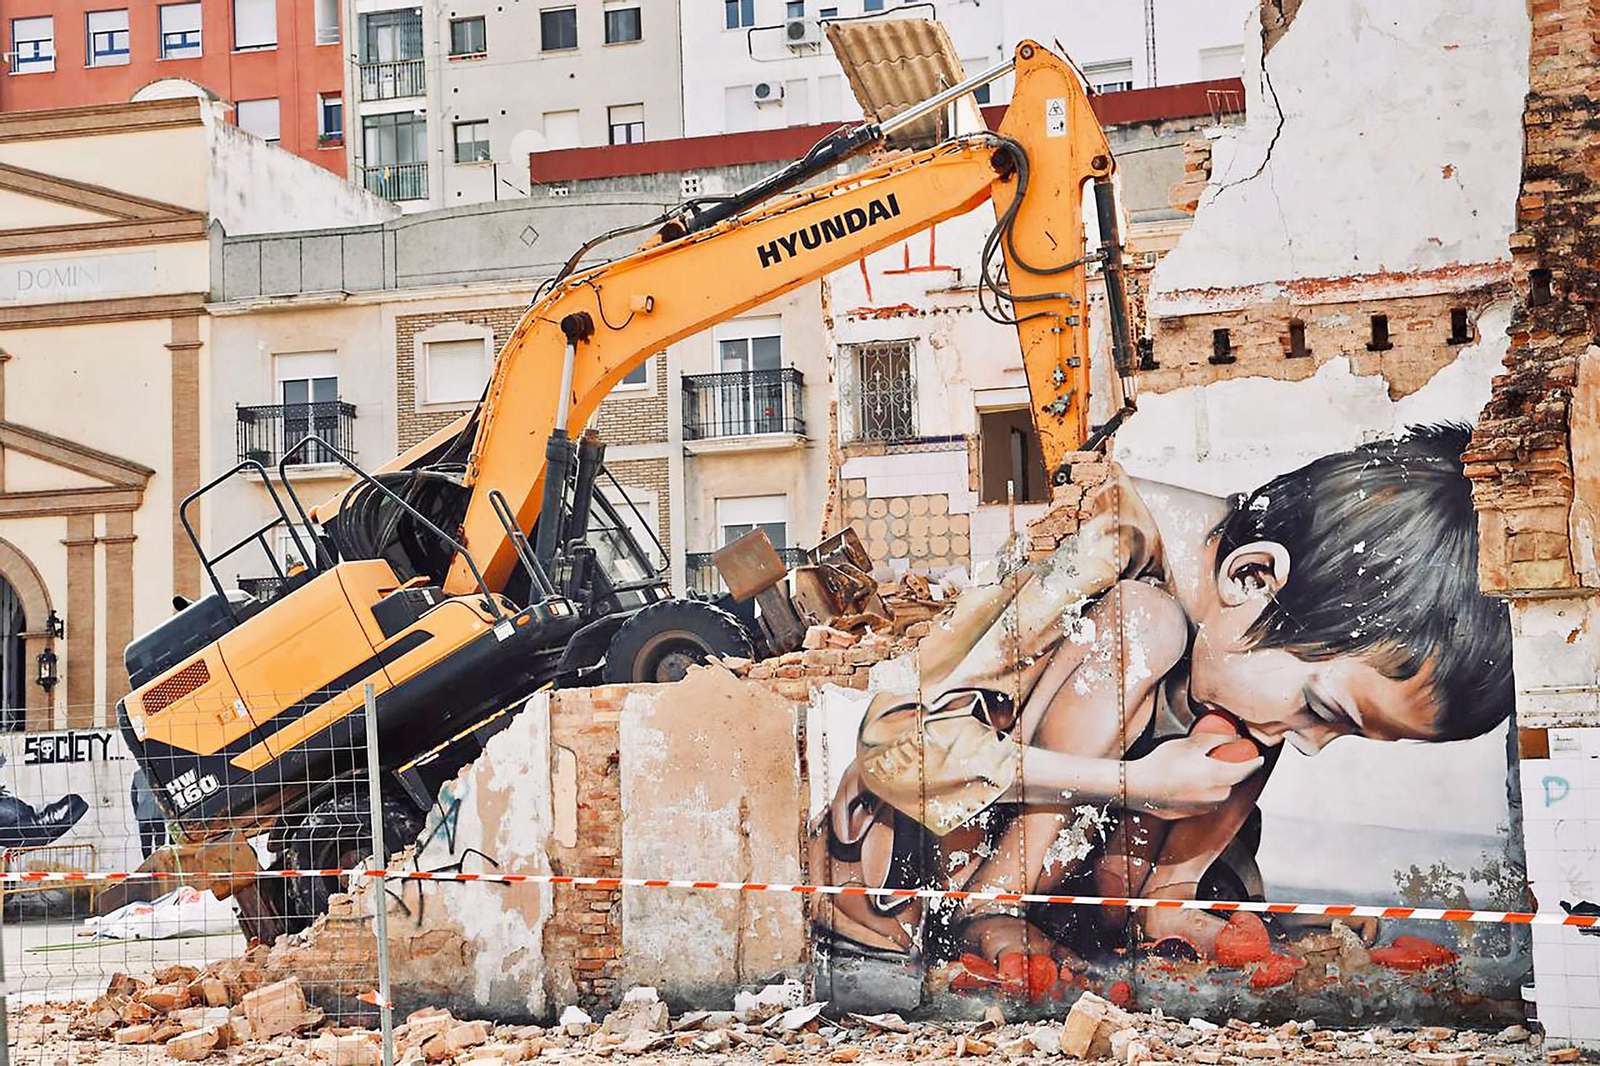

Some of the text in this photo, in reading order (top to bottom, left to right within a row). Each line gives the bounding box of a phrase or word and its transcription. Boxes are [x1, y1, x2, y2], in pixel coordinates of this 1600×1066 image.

[756, 192, 901, 268] HYUNDAI
[165, 768, 198, 796] HW
[172, 773, 219, 810] 160
